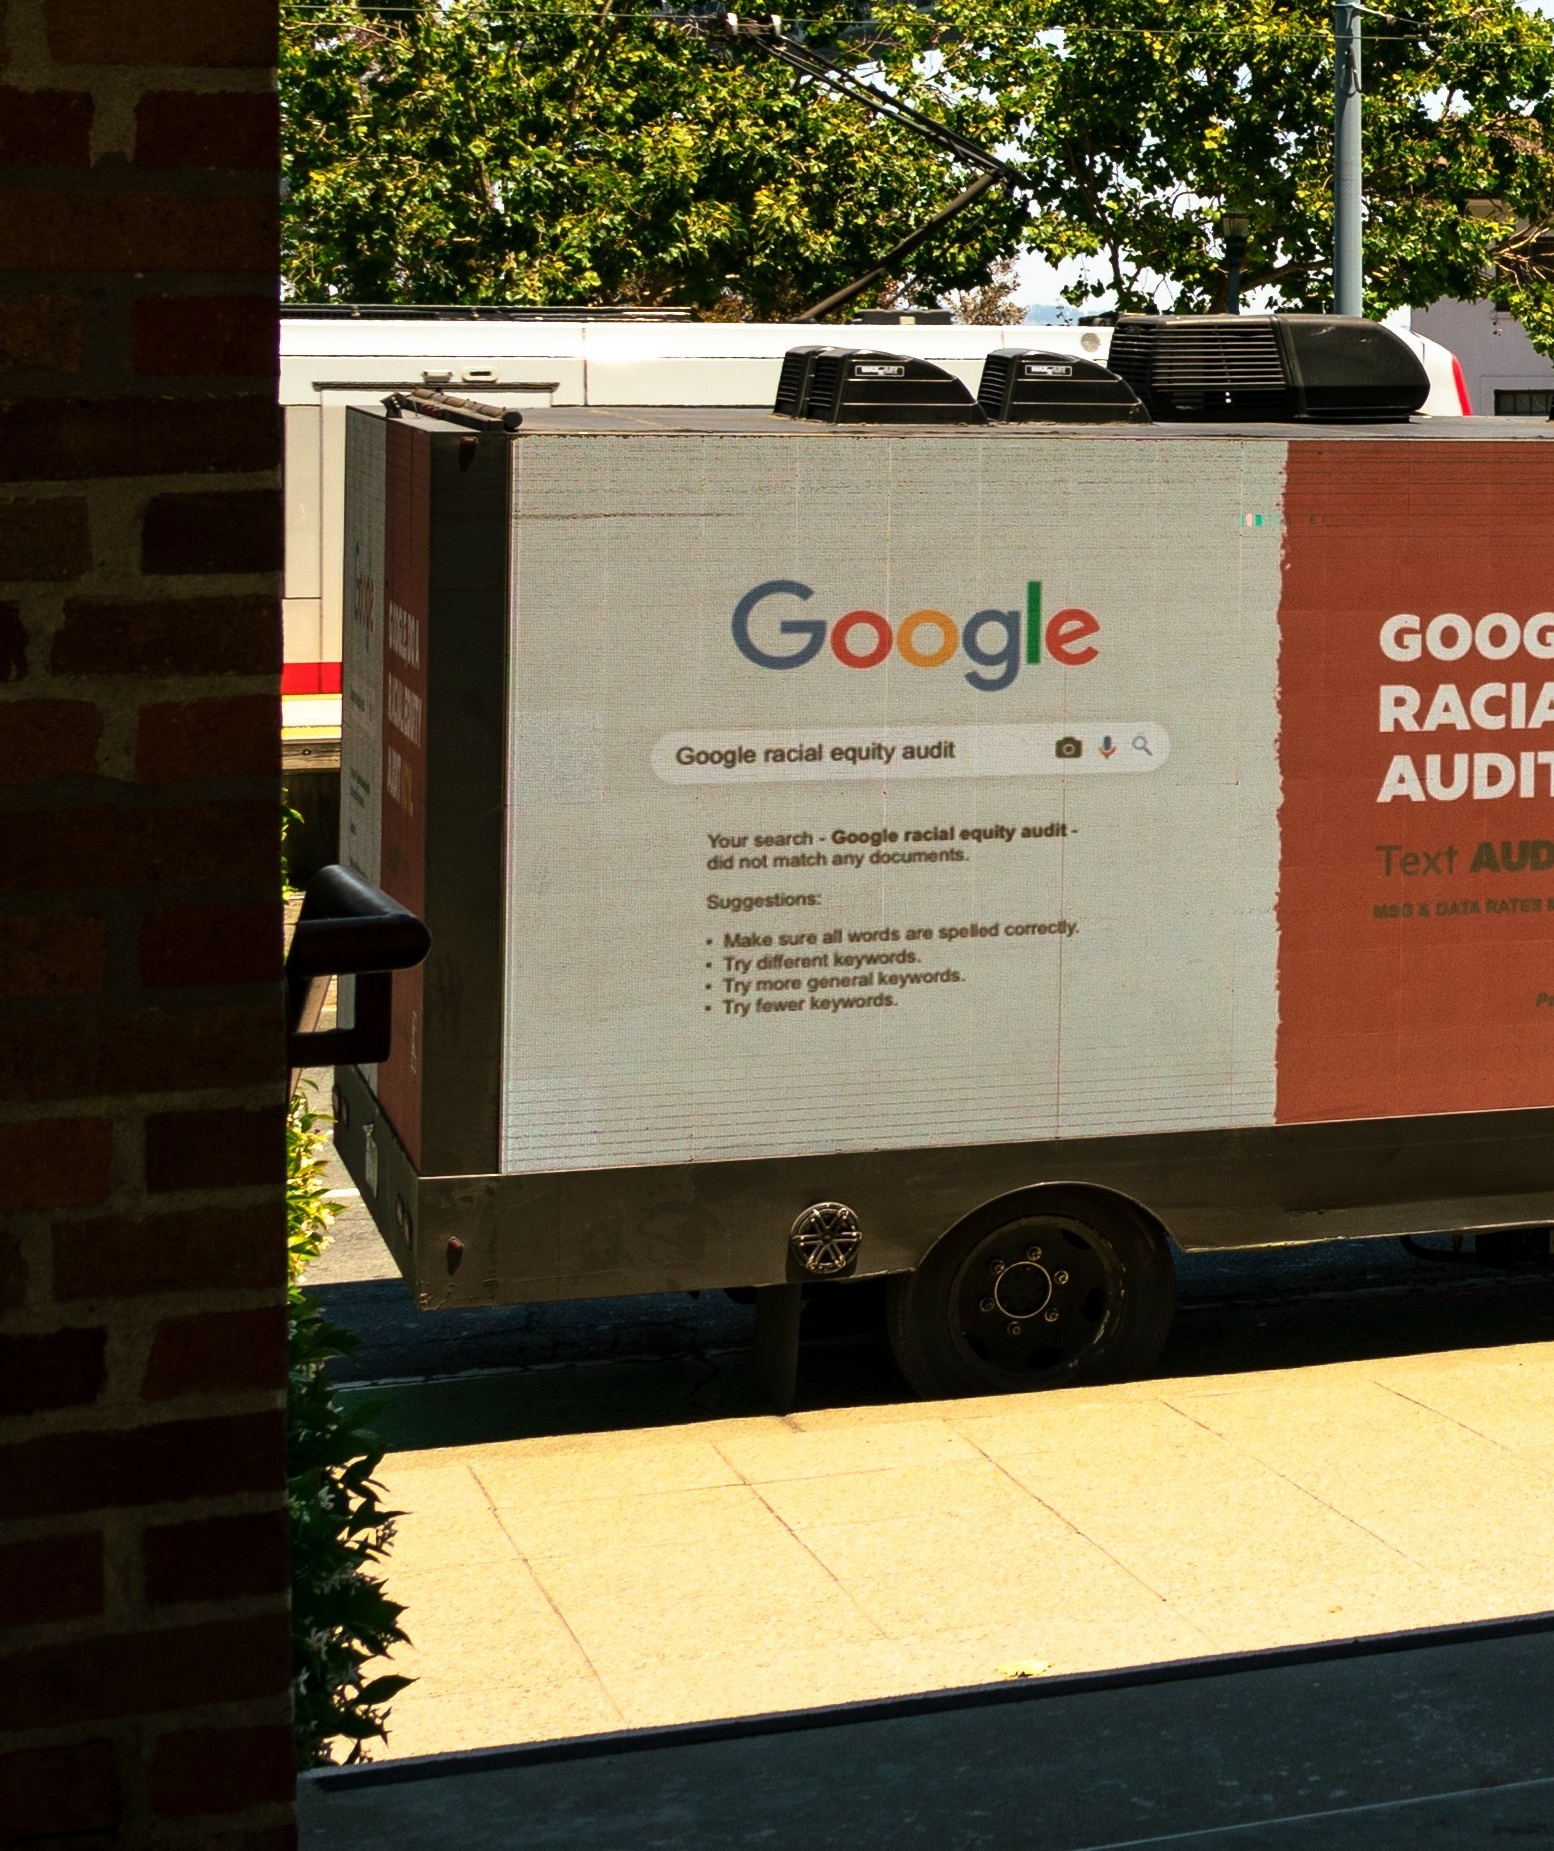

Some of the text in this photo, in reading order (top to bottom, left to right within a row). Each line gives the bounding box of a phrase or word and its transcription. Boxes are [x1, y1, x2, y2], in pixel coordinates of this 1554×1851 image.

[731, 579, 1101, 692] Google
[675, 741, 955, 769] Google racial equity audit
[707, 833, 749, 849] Your
[753, 831, 814, 848] search
[831, 828, 898, 847] Google
[904, 826, 955, 842] racial
[959, 824, 1016, 843] equity
[1021, 822, 1067, 838] audit
[706, 848, 970, 870] did not match any documents.
[1375, 844, 1459, 877] Text
[706, 892, 822, 913] Suggestions:
[1435, 900, 1482, 917] DATA
[1485, 897, 1543, 914] RATES
[723, 919, 1080, 948] Make sure all words are spelled correctly.
[723, 949, 922, 975] Try different keywords.
[723, 967, 966, 996] Try more general keywords.
[722, 992, 899, 1017] Try fewer keywords.
